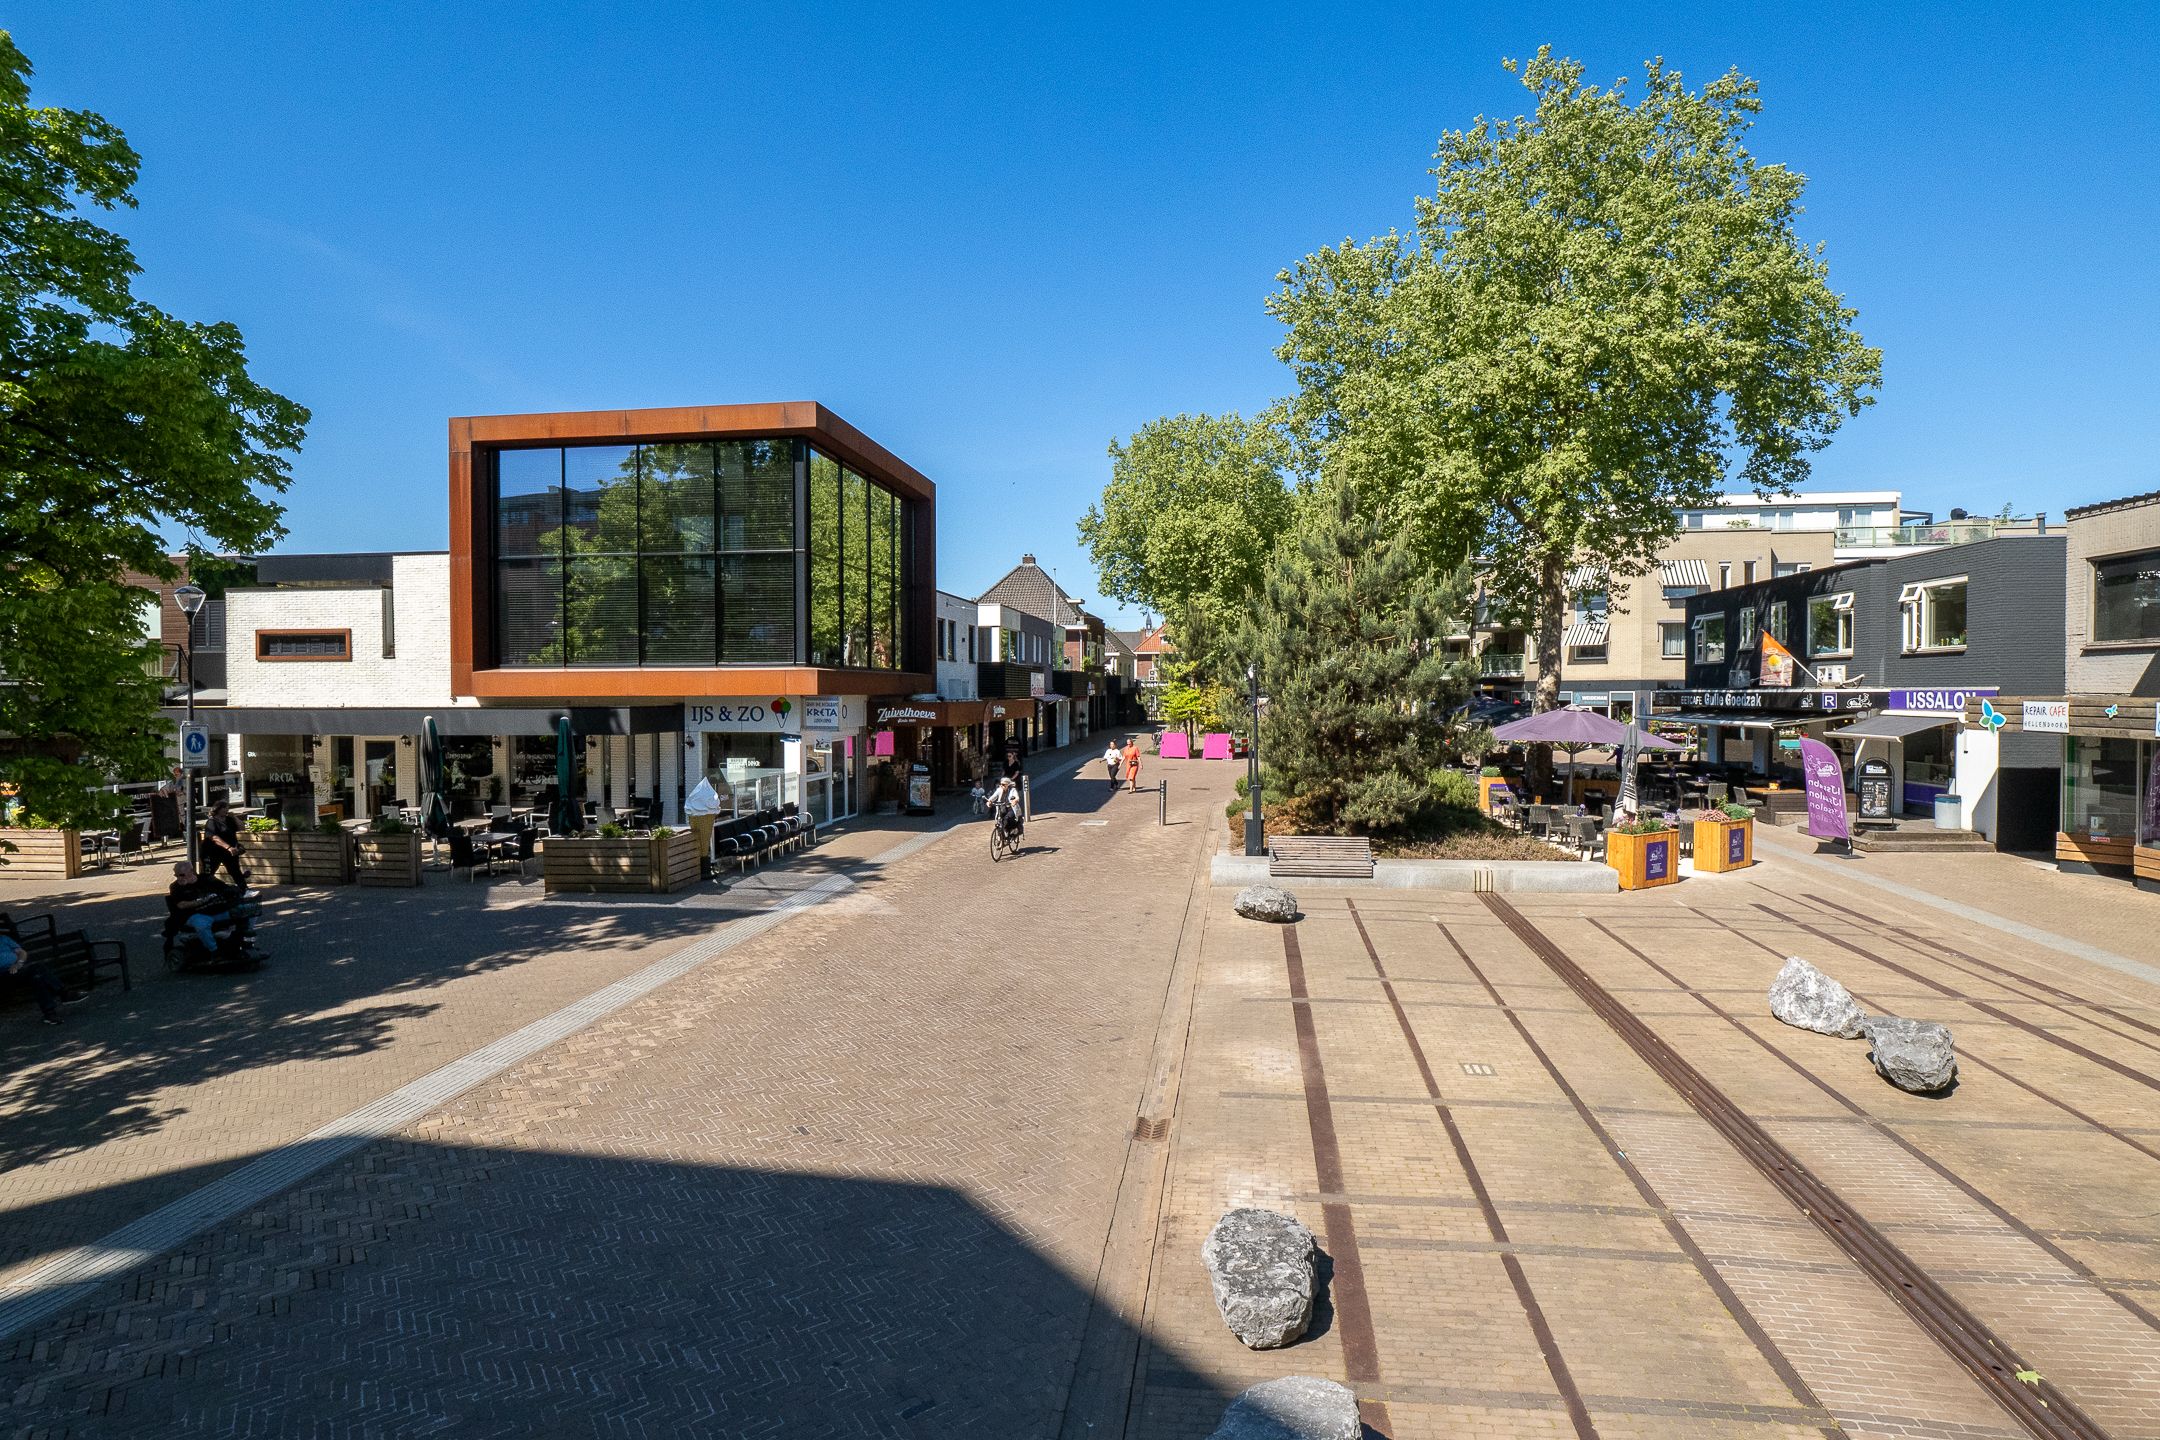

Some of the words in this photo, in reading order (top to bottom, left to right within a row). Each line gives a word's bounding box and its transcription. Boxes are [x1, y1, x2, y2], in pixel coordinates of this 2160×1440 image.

[1725, 693, 1762, 707] Goedzak
[691, 706, 714, 725] IJS
[718, 706, 733, 722] &
[737, 706, 765, 722] ZO
[877, 707, 936, 722] Zuivelhoeve
[2024, 705, 2047, 716] REPAIR
[2049, 705, 2067, 717] CAFE
[2024, 720, 2068, 730] HELLENDOORN
